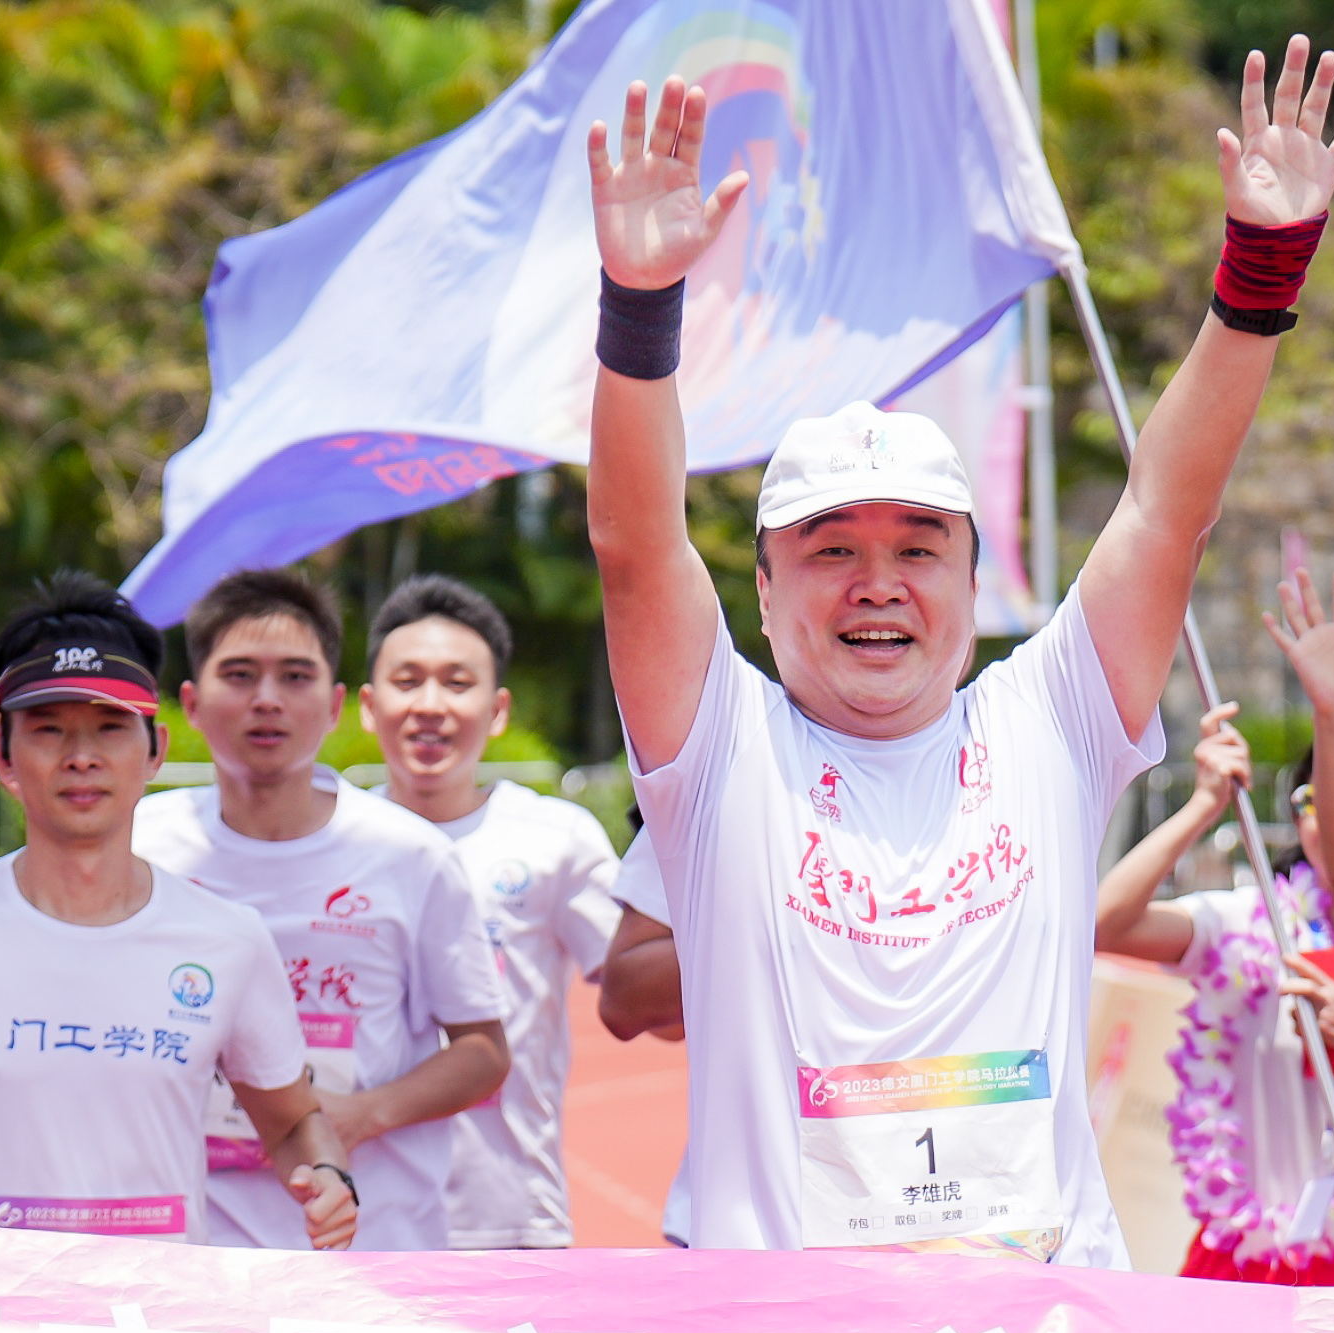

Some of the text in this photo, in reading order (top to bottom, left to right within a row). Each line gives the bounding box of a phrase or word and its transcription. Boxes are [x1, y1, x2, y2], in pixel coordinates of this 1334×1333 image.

[785, 893, 842, 937] XIAMEN
[842, 1065, 1031, 1094] 2023德文厦门工学院马拉松赛
[915, 1127, 936, 1174] 1
[902, 1181, 962, 1205] 李雄虎
[848, 1204, 1009, 1230] 存包 取包 奖牌 退赛
